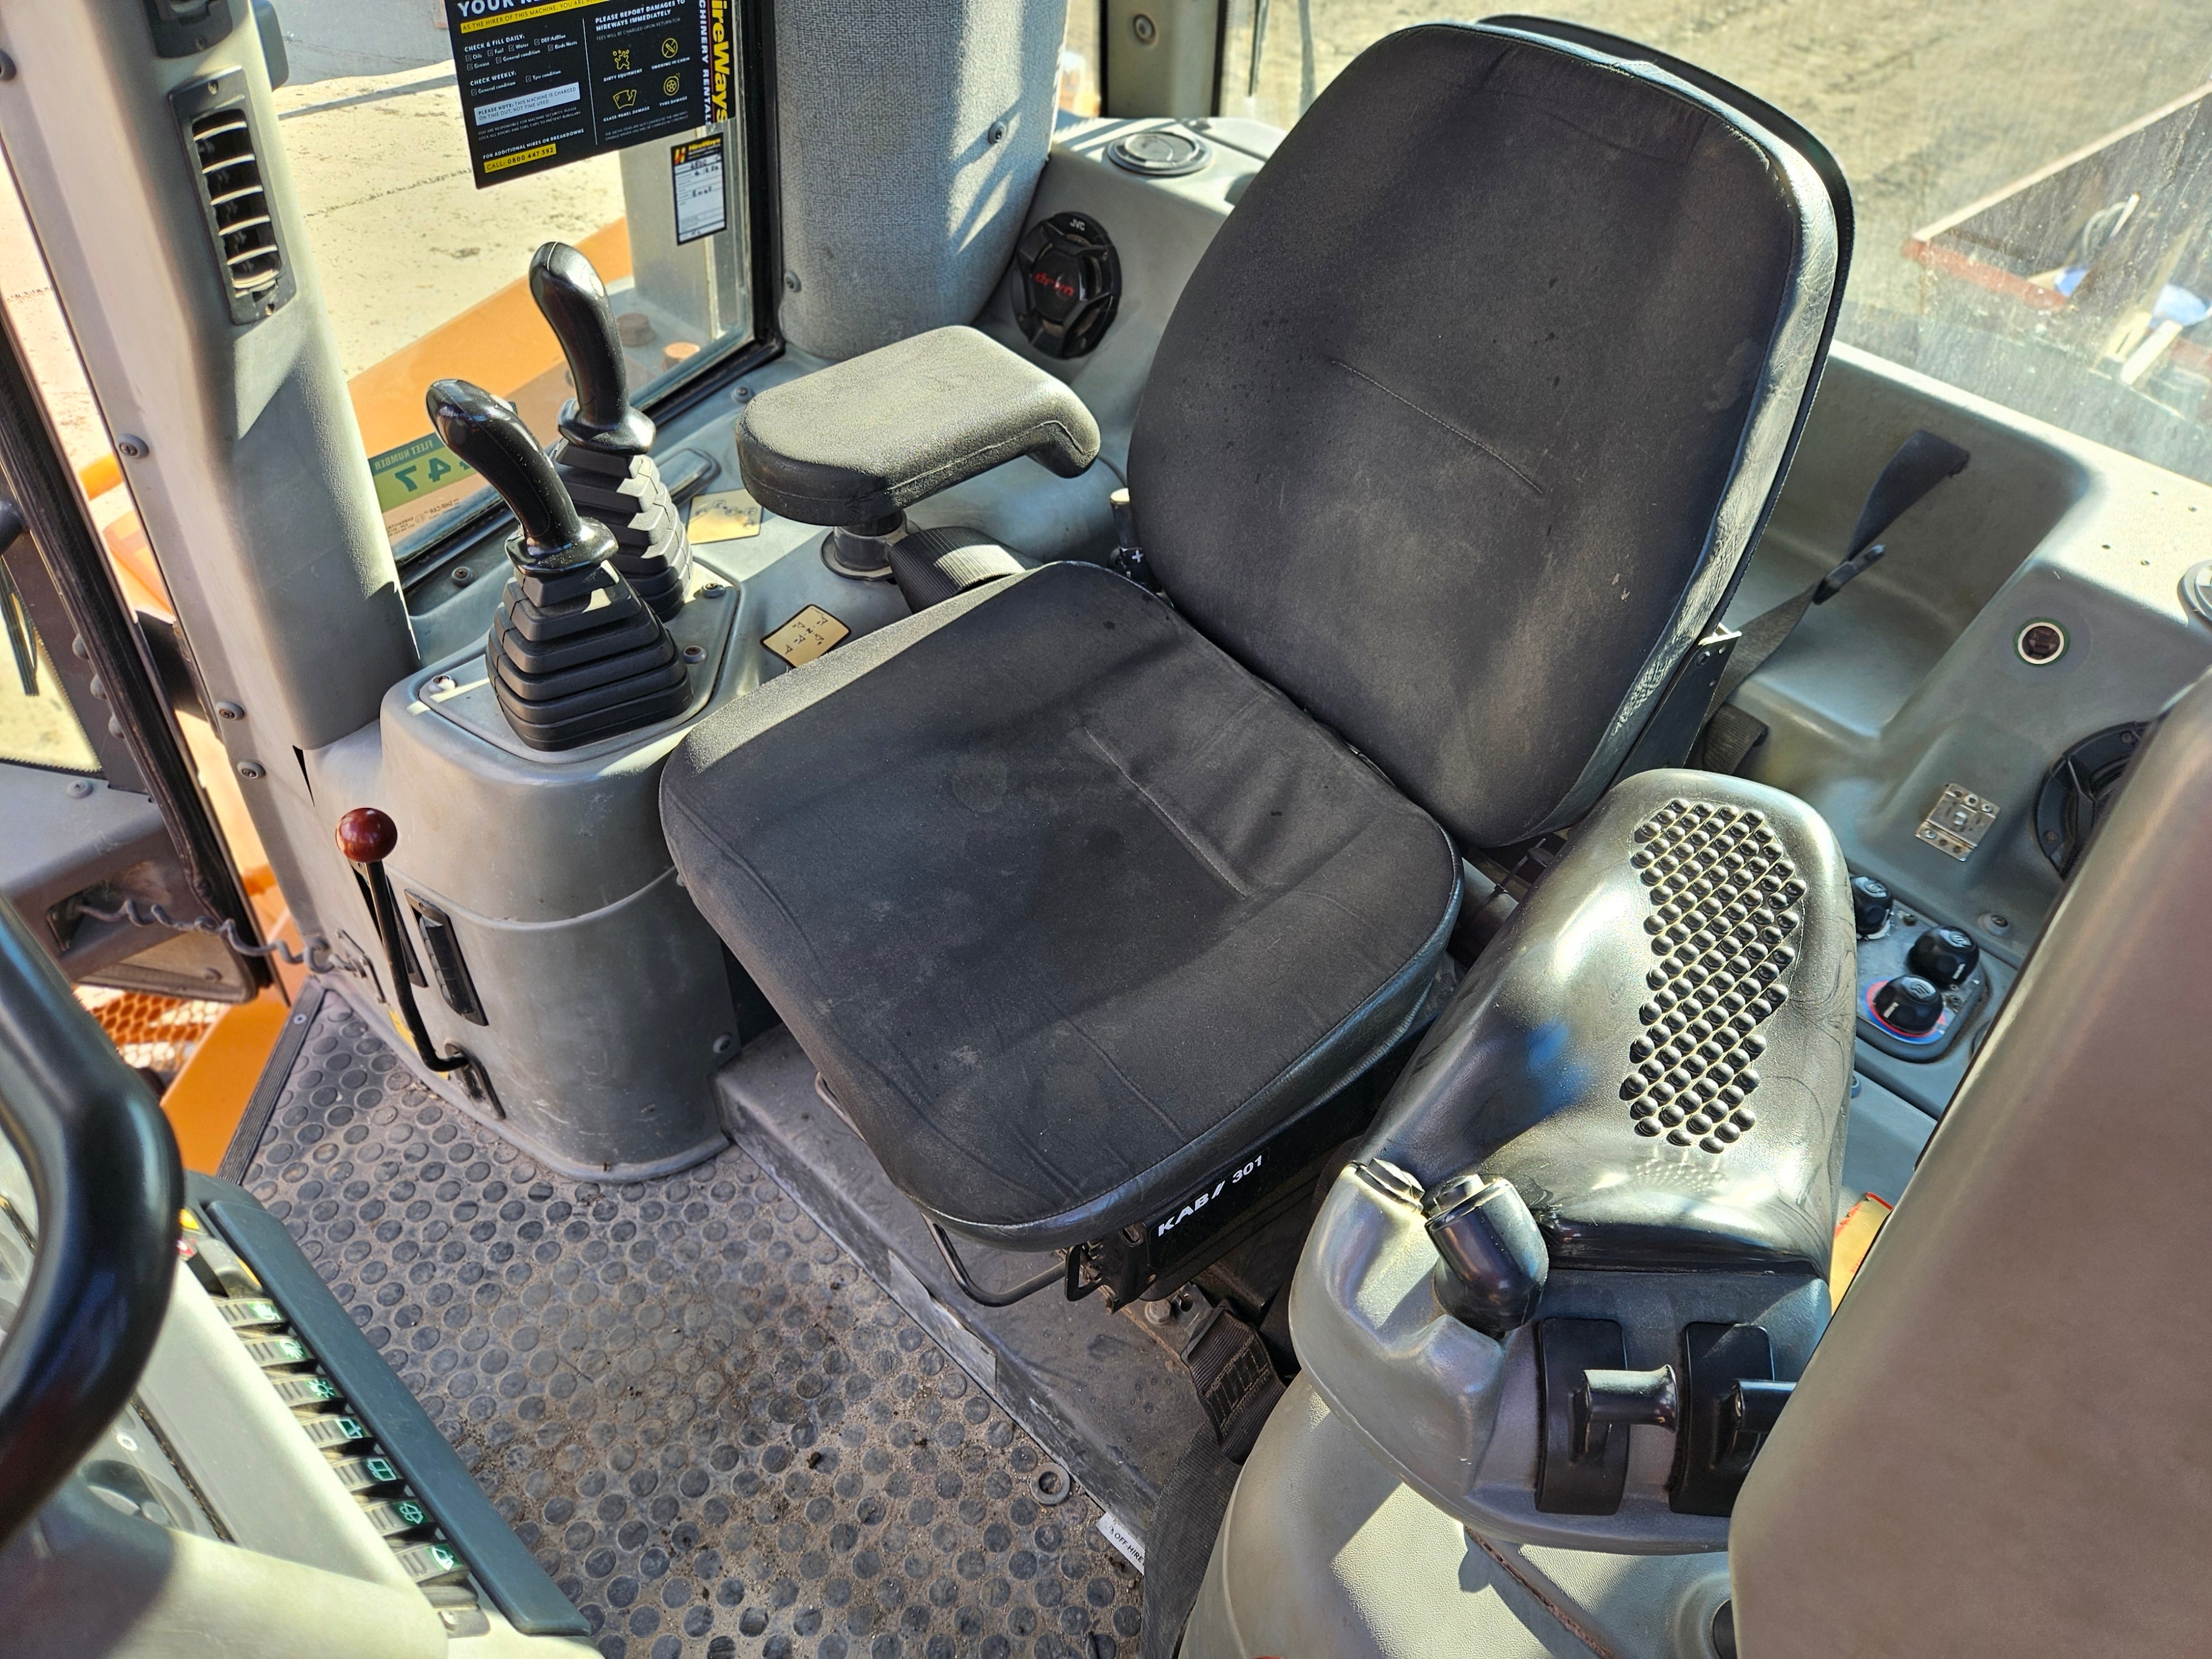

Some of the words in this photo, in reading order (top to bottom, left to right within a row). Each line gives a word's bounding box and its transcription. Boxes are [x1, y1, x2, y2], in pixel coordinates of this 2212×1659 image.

[486, 17, 503, 25] HIRER
[530, 6, 558, 16] MACHINE,
[594, 13, 618, 24] PLEASE
[619, 7, 645, 18] REPORT
[645, 0, 676, 12] DAMAGES
[596, 19, 628, 32] HIREWAYS
[629, 9, 671, 24] IMMEDIATELY
[623, 27, 643, 35] CHARGED
[464, 43, 484, 52] CHECK
[505, 34, 525, 43] DAILY:
[469, 77, 490, 86] CHECK
[491, 71, 517, 80] WEEKLY:
[617, 69, 643, 78] EQUIPMENT
[478, 85, 495, 93] General
[554, 87, 576, 96] CHARGED
[494, 145, 525, 155] ADDITIONAL
[550, 129, 584, 140] BREAKDOWNS
[487, 161, 505, 169] CALL:
[1070, 219, 1085, 231] JVC
[1158, 1193, 1209, 1237] KAB
[1232, 1155, 1262, 1183] 301
[1114, 1533, 1144, 1563] OFF-HIRE
